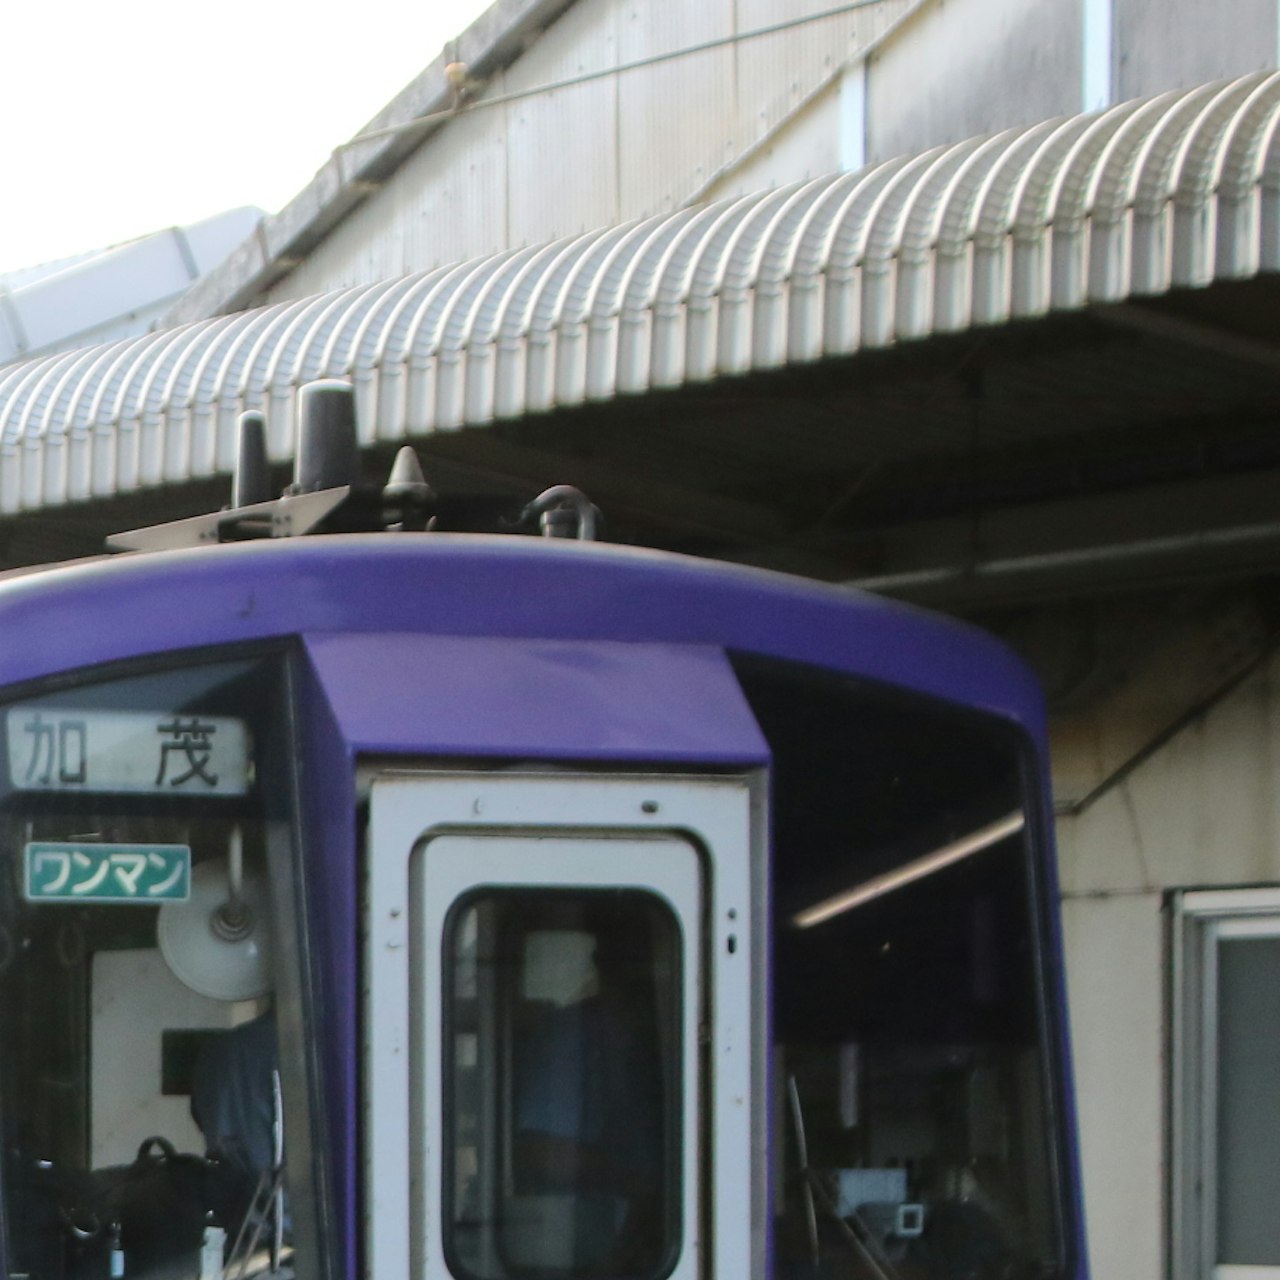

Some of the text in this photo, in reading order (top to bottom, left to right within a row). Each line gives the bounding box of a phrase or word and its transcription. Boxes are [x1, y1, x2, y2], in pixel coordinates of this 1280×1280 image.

[23, 716, 219, 788] 加茂
[34, 851, 184, 895] ワンマン
